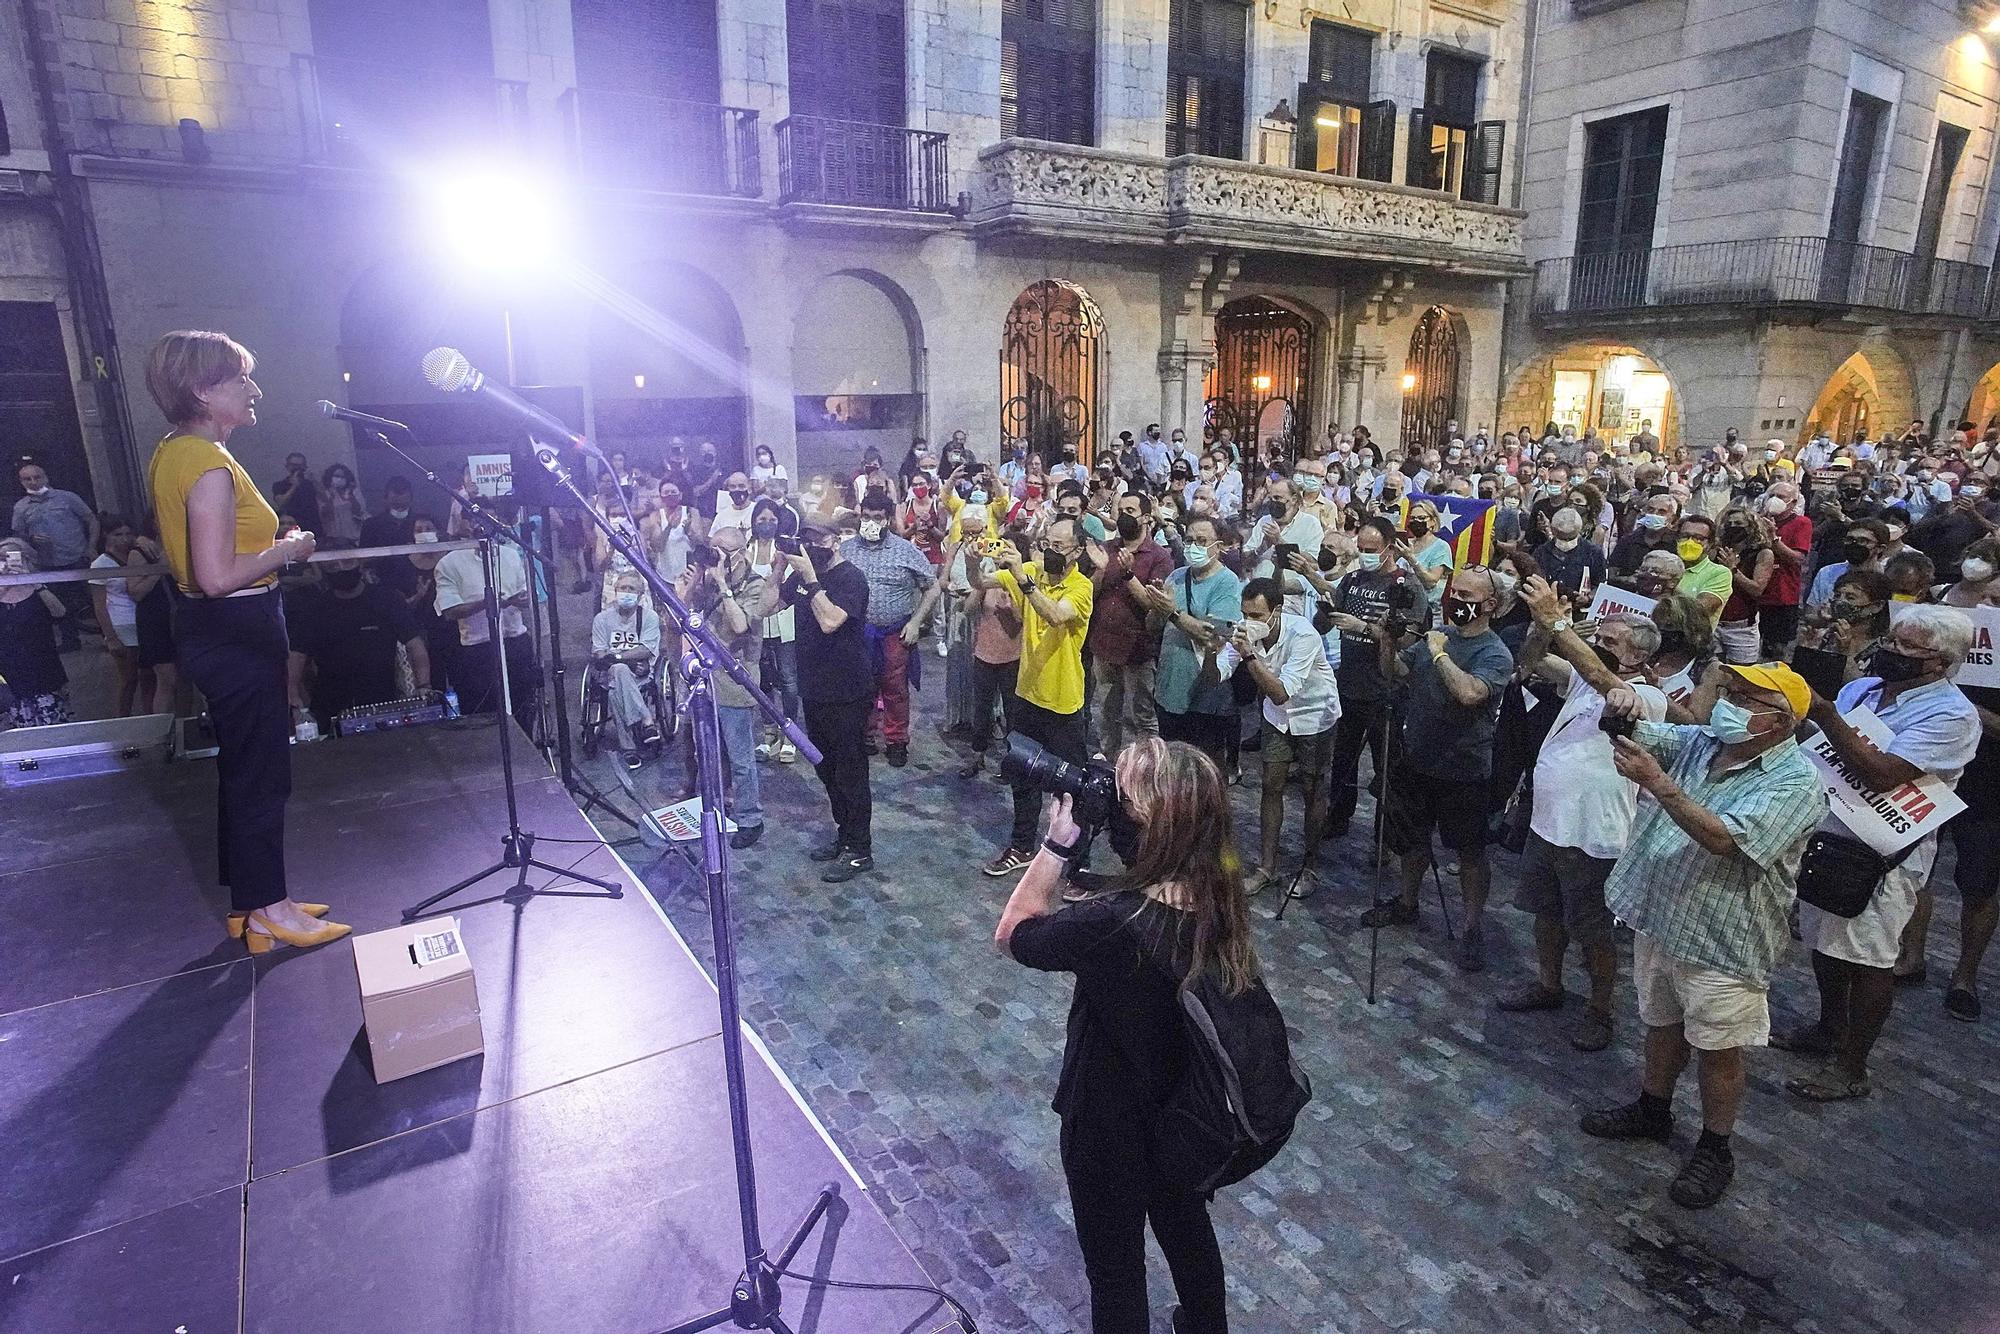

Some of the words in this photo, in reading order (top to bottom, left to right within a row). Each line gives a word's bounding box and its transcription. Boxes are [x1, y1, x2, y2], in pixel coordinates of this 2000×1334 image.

[476, 463, 511, 475] AMNIS
[1834, 793, 1856, 814] OMNIUM
[1859, 786, 1912, 834] LLIURES
